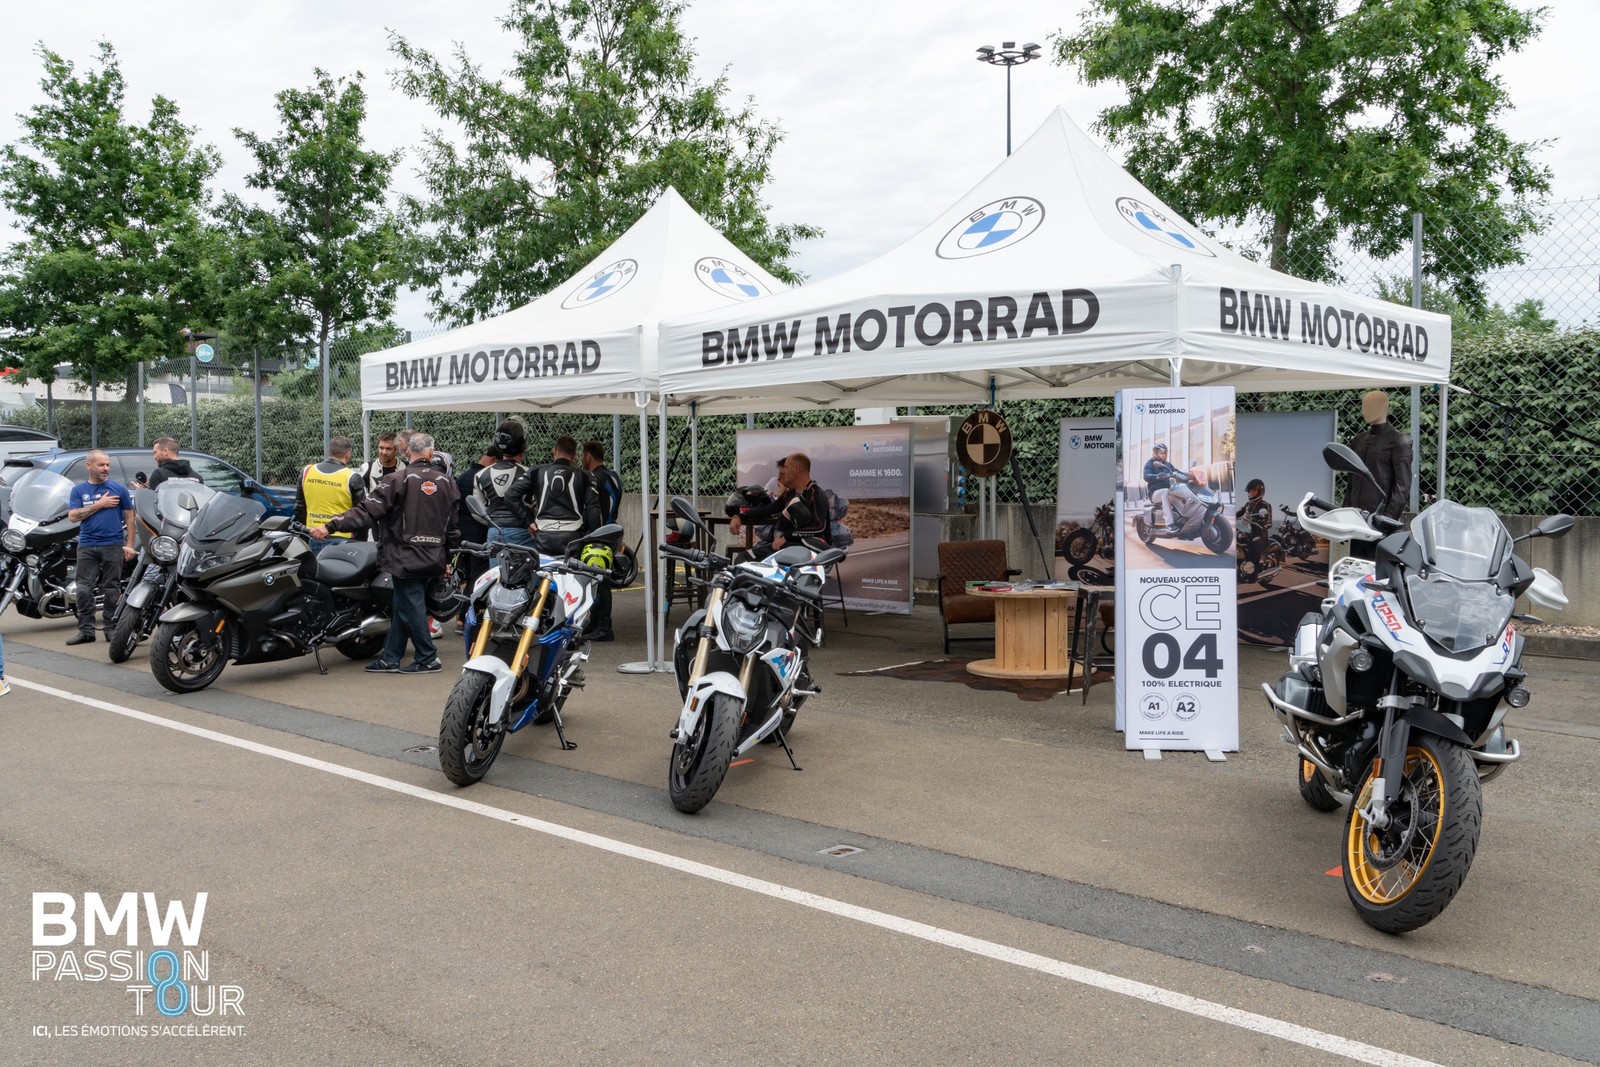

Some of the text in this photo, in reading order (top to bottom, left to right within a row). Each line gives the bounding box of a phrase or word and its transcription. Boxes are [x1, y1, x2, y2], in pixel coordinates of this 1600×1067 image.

[969, 200, 1038, 223] BMW
[1121, 201, 1166, 222] BMW
[699, 260, 747, 276] BMW
[701, 288, 1099, 367] BMW MOTORRAD
[1219, 286, 1428, 362] BMW MOTORRAD
[385, 339, 601, 391] BMW MOTORRAD
[961, 413, 1007, 434] BMW
[307, 479, 342, 487] INSTRUCTEUR
[849, 469, 876, 477] GAMME
[883, 468, 903, 477] 1600.
[1139, 584, 1221, 631] CE
[1142, 632, 1223, 679] 04
[1168, 680, 1222, 688] ELECTRIQUE
[1148, 702, 1160, 710] A1
[1176, 701, 1196, 712] A2
